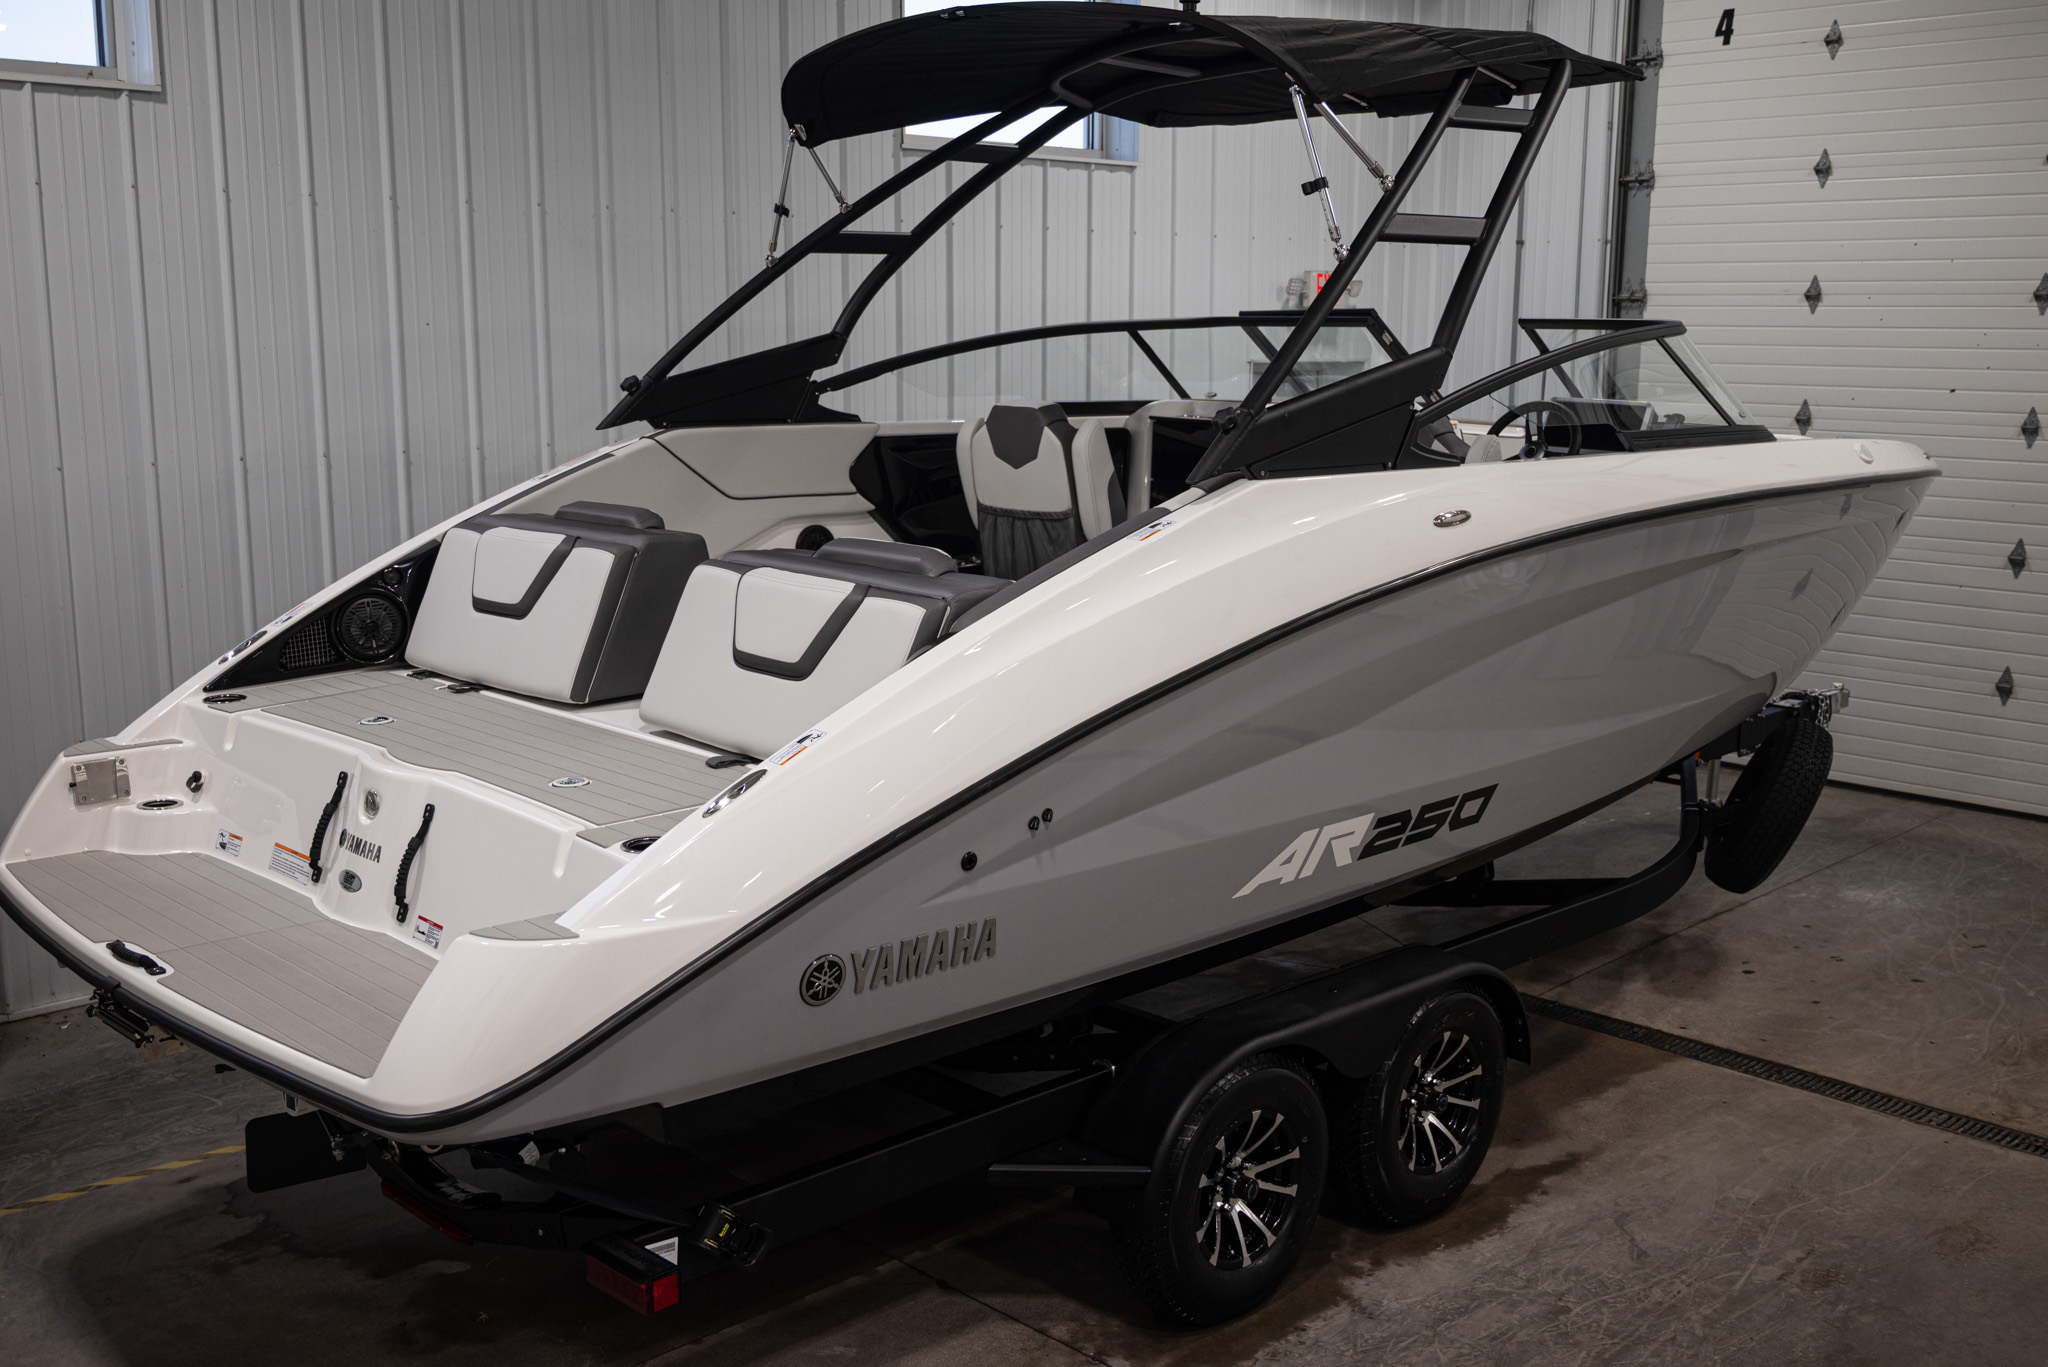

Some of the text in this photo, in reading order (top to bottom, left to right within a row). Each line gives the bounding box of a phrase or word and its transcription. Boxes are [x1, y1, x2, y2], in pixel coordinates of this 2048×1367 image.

[1715, 8, 1735, 46] 4
[345, 832, 382, 863] YAMAHA
[1232, 783, 1499, 899] AR250
[851, 916, 997, 994] YAMAHA
